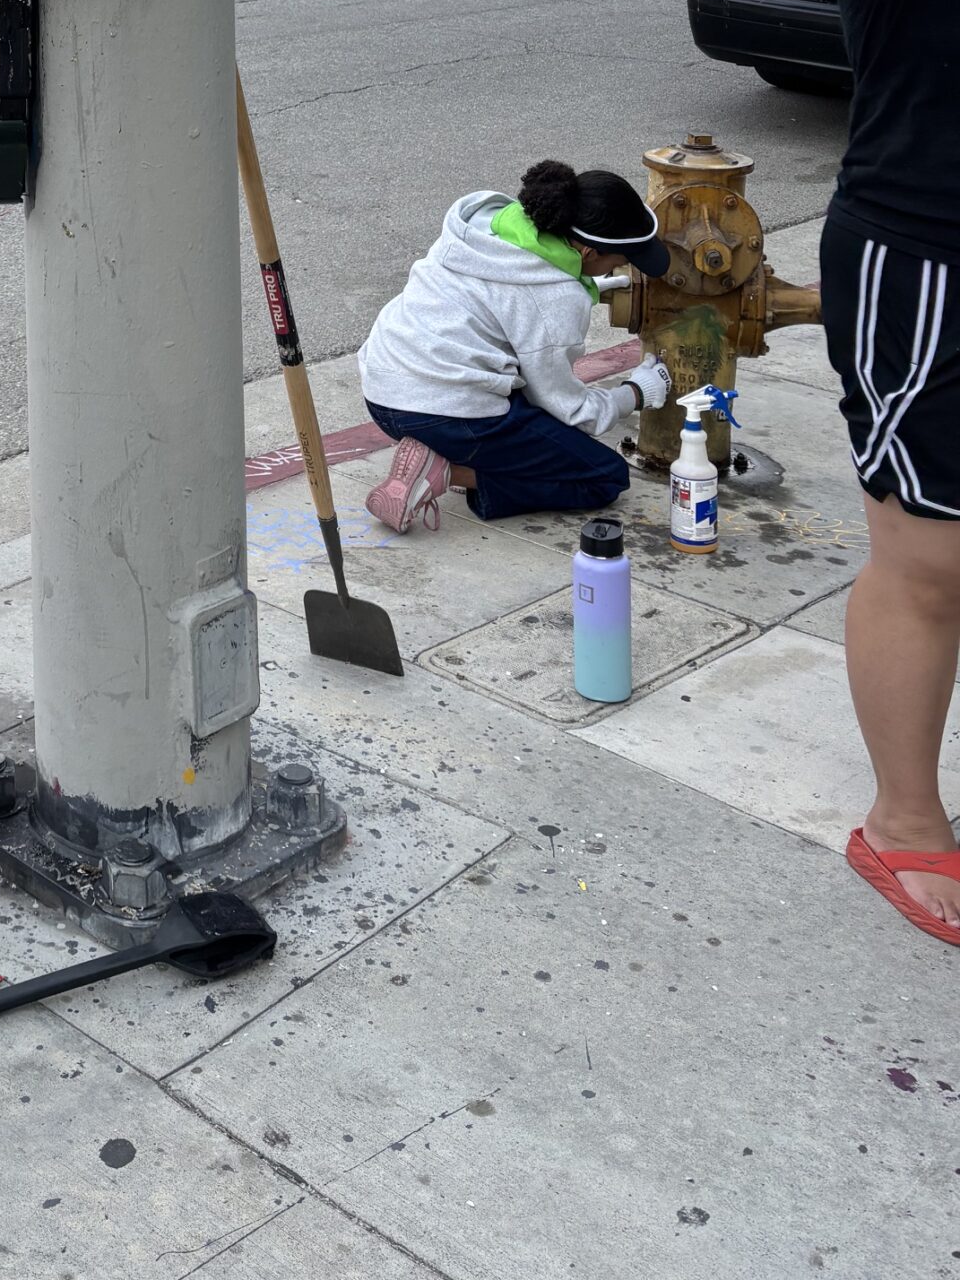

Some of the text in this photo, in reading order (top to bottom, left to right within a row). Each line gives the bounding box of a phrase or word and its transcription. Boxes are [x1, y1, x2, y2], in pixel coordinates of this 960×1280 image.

[265, 275, 286, 330] TRU PRO
[299, 431, 315, 475] TRUPER
